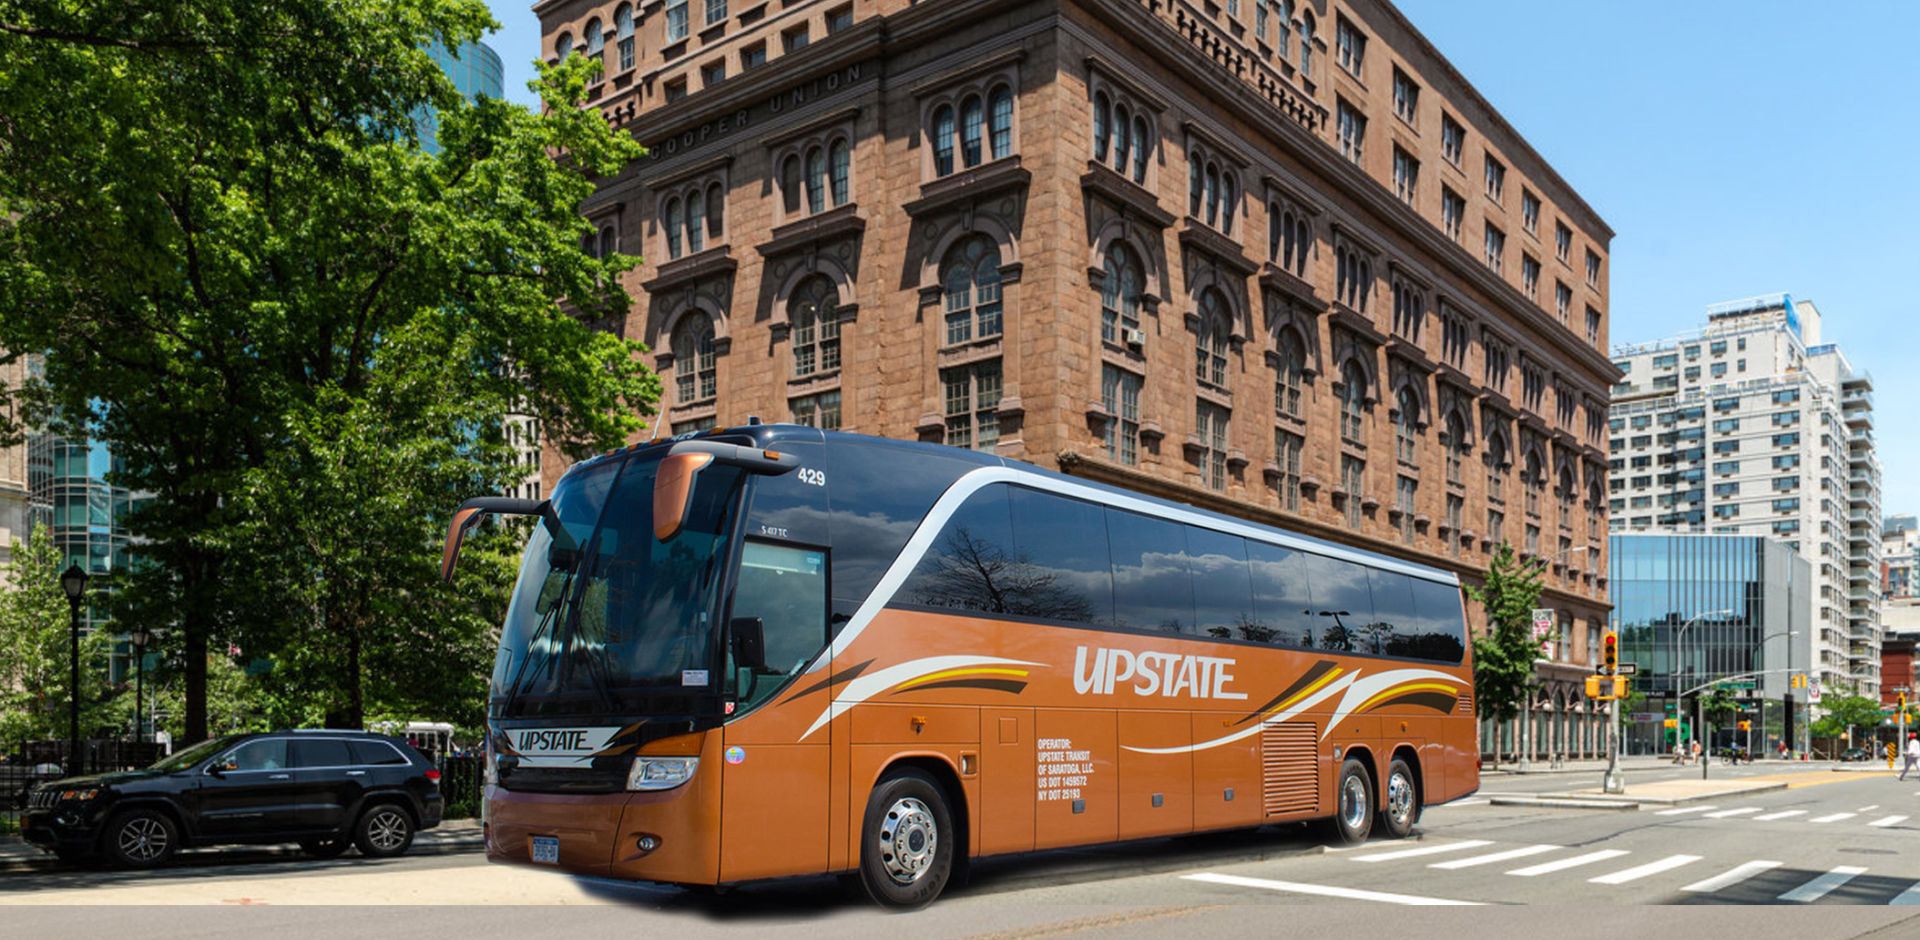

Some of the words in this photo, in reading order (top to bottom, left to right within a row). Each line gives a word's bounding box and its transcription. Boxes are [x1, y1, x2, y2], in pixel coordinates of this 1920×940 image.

[649, 109, 749, 161] COOPER
[769, 64, 862, 113] UNION
[797, 467, 826, 487] 429
[1073, 645, 1249, 700] UPSTATE
[519, 730, 594, 751] UPSTATE
[1038, 738, 1072, 750] OPERATOR:
[1038, 751, 1064, 762] UPSTATE
[1065, 750, 1091, 761] TRANSIT
[1038, 764, 1047, 775] OF
[1047, 763, 1081, 775] SARATOGA,
[1038, 777, 1047, 788] US
[1048, 776, 1061, 787] DOT
[1038, 790, 1047, 801] NY
[1048, 789, 1061, 801] DOT
